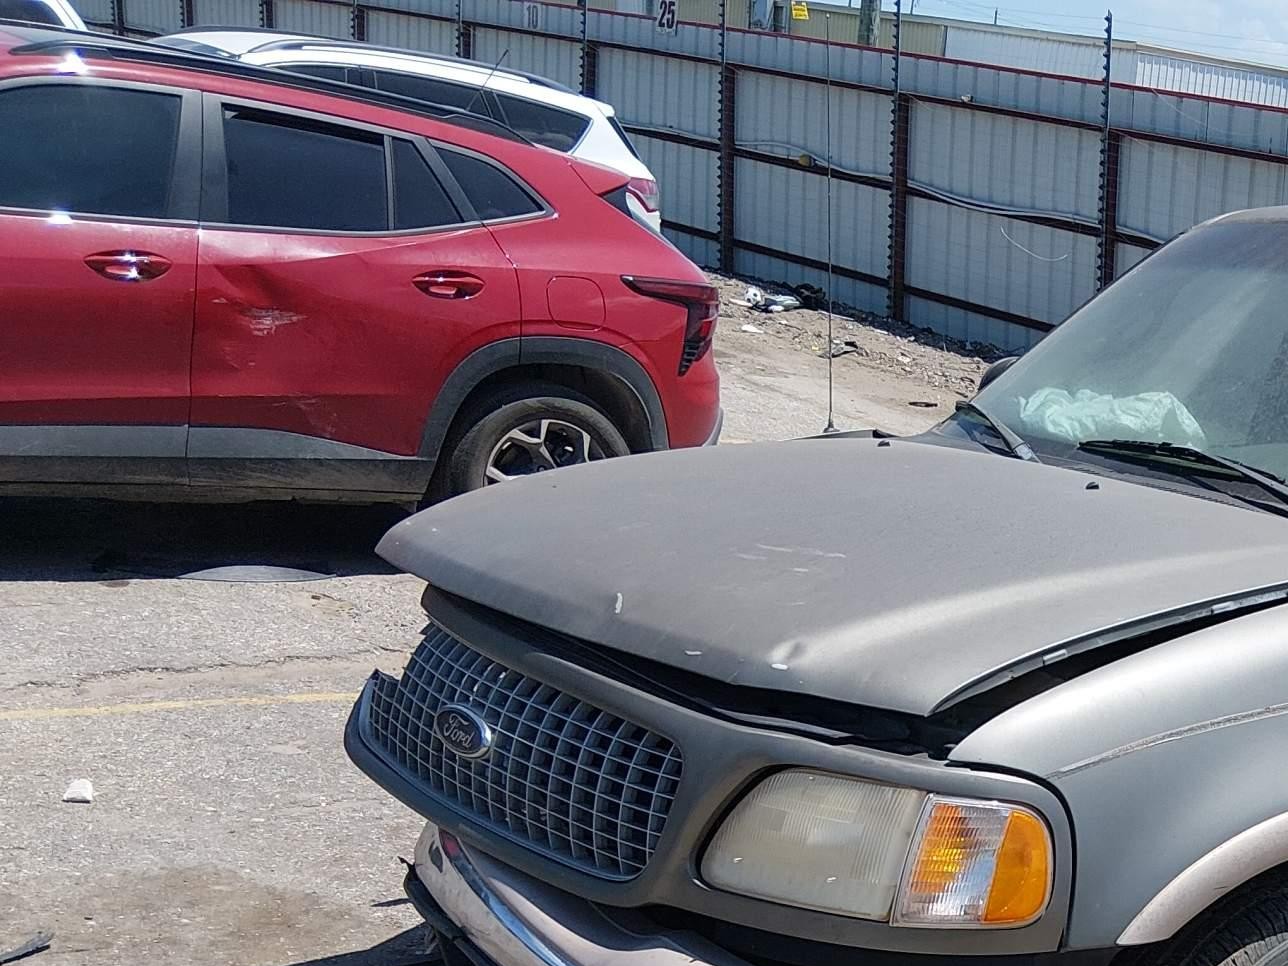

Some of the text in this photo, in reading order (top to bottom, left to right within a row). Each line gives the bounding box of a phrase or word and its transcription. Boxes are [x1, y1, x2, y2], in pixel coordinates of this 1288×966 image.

[526, 4, 539, 29] 10
[658, 0, 676, 29] 25
[443, 713, 476, 748] Ford
